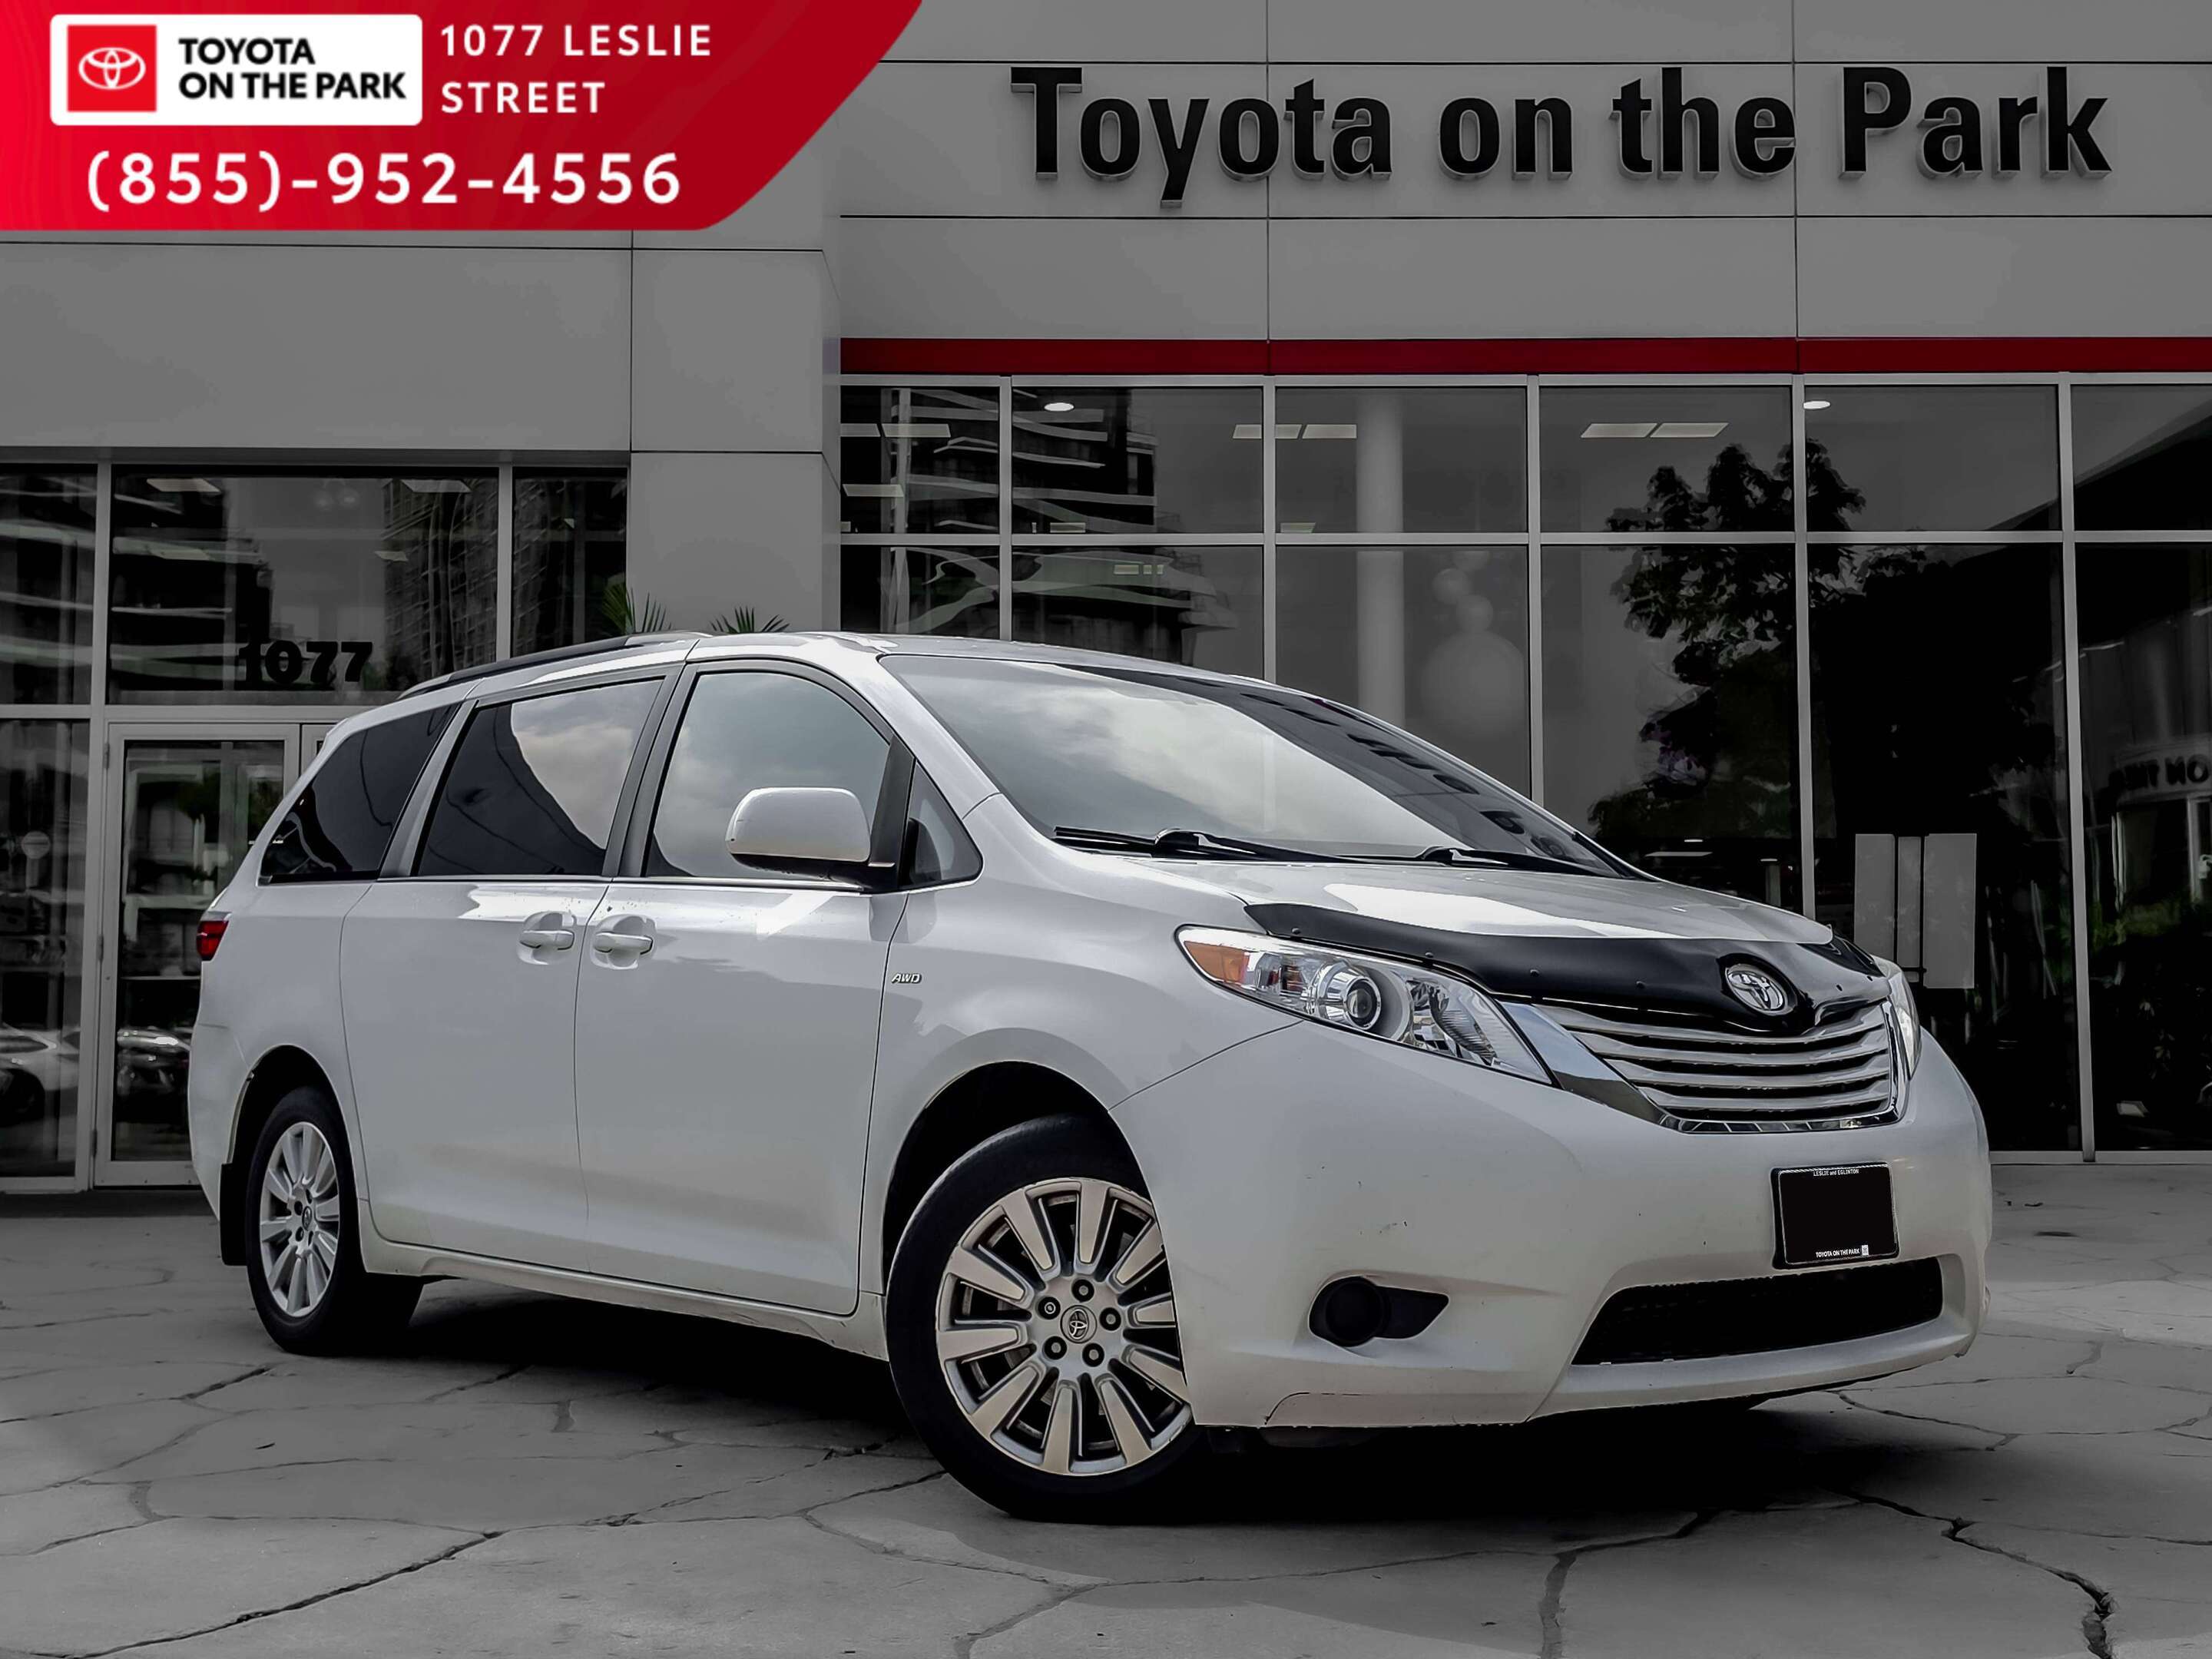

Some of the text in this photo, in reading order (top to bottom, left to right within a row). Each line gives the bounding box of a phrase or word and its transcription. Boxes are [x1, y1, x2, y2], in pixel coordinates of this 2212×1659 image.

[1011, 66, 2113, 204] Toyota on the Park
[239, 641, 373, 684] 1077
[891, 973, 922, 983] AWD
